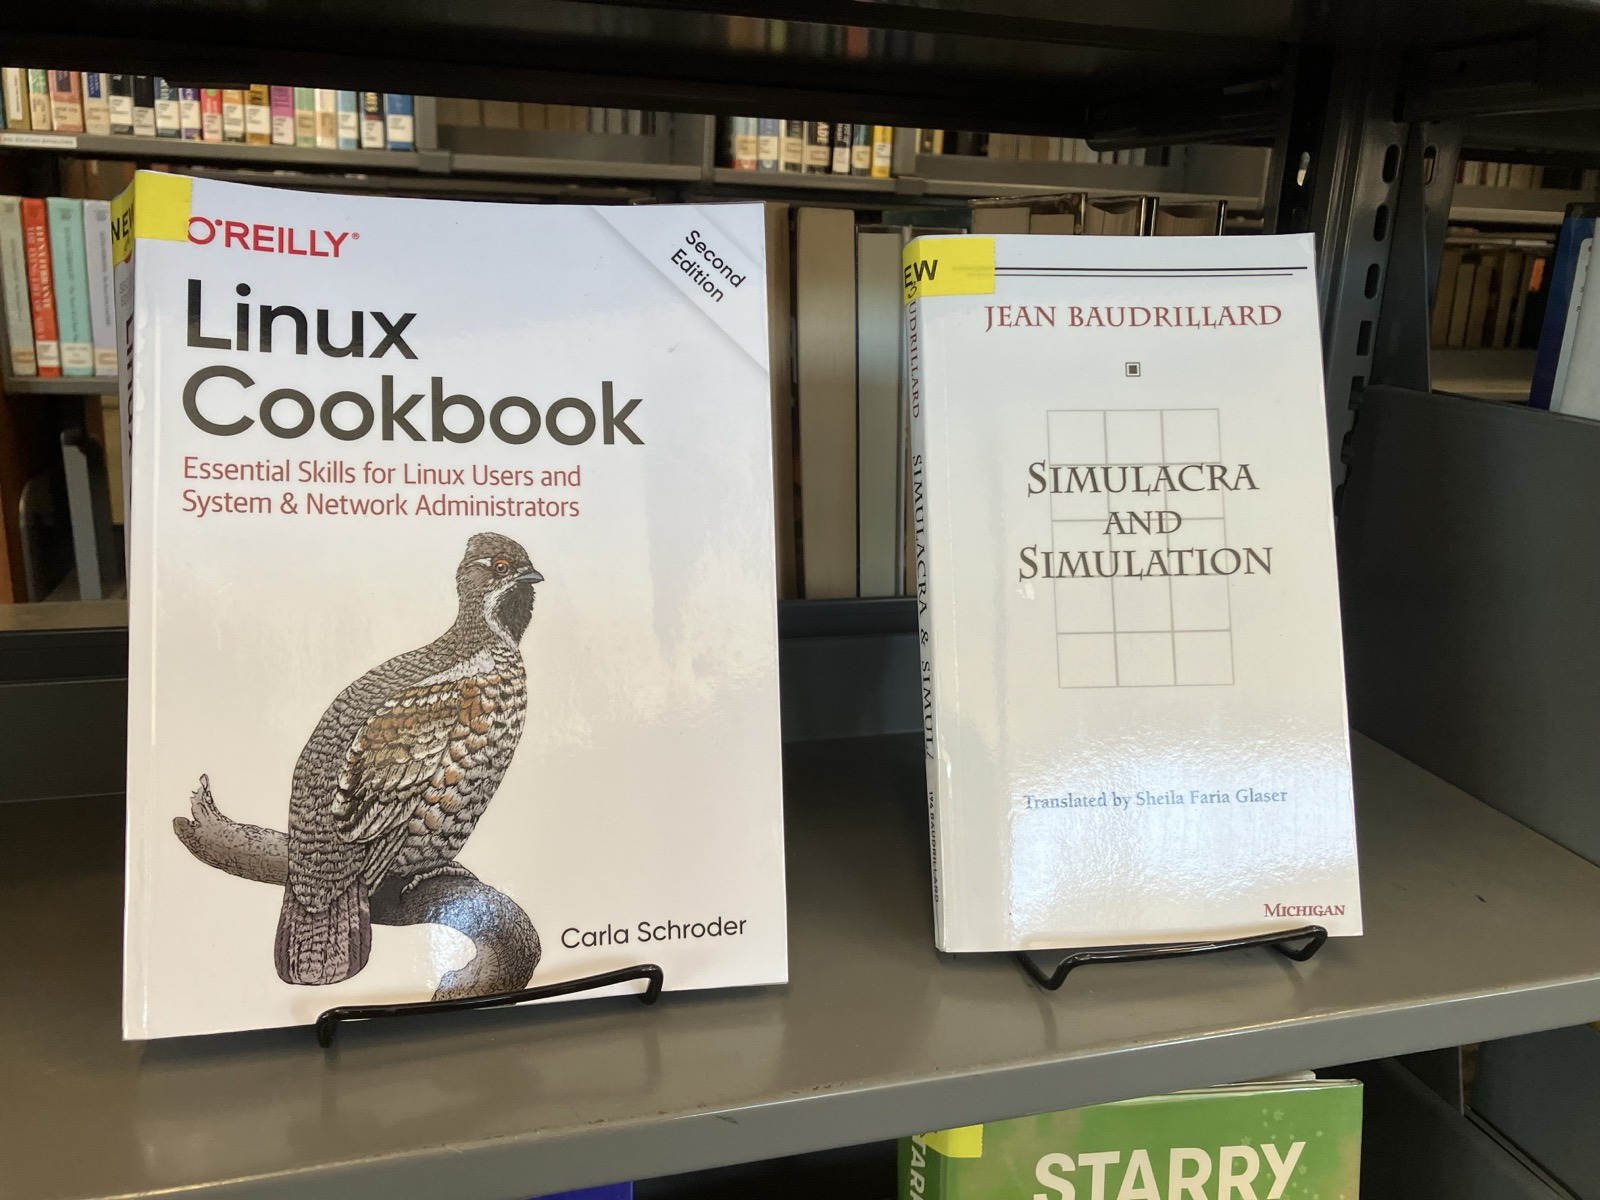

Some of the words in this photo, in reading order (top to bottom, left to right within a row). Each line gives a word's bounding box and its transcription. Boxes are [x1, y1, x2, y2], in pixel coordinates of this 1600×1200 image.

[670, 248, 725, 303] Edition
[685, 230, 747, 288] Second
[904, 259, 939, 289] EW
[187, 278, 419, 360] Linux
[984, 305, 1056, 333] JEAN
[1068, 304, 1282, 329] BAUDRILLARD
[908, 301, 920, 418] UDRILLARD
[182, 365, 645, 446] Cookbook
[184, 456, 290, 482] Essential
[298, 460, 356, 484] Skills
[363, 461, 396, 484] for
[404, 463, 465, 485] Linux
[472, 464, 534, 486] Users
[541, 464, 581, 487] and
[1027, 459, 1260, 498] SIMULACRA
[182, 489, 272, 518] System
[280, 492, 298, 514] &
[306, 492, 408, 516] Network
[415, 494, 580, 517] Administrators
[1102, 510, 1182, 535] AND
[912, 454, 928, 615] SIMULACRA
[1018, 544, 1273, 583] SIMULATION
[920, 628, 929, 646] &
[1023, 791, 1108, 810] Translated
[1112, 791, 1130, 811] by
[1136, 790, 1185, 806] Sheila
[1189, 789, 1231, 805] Faria
[1235, 788, 1288, 804] Glaser
[1263, 903, 1346, 918] MICHIGAN
[561, 923, 629, 949] Carla
[637, 916, 747, 942] Schroder
[909, 1135, 926, 1200] TAR
[1033, 1141, 1306, 1200] STARRY
